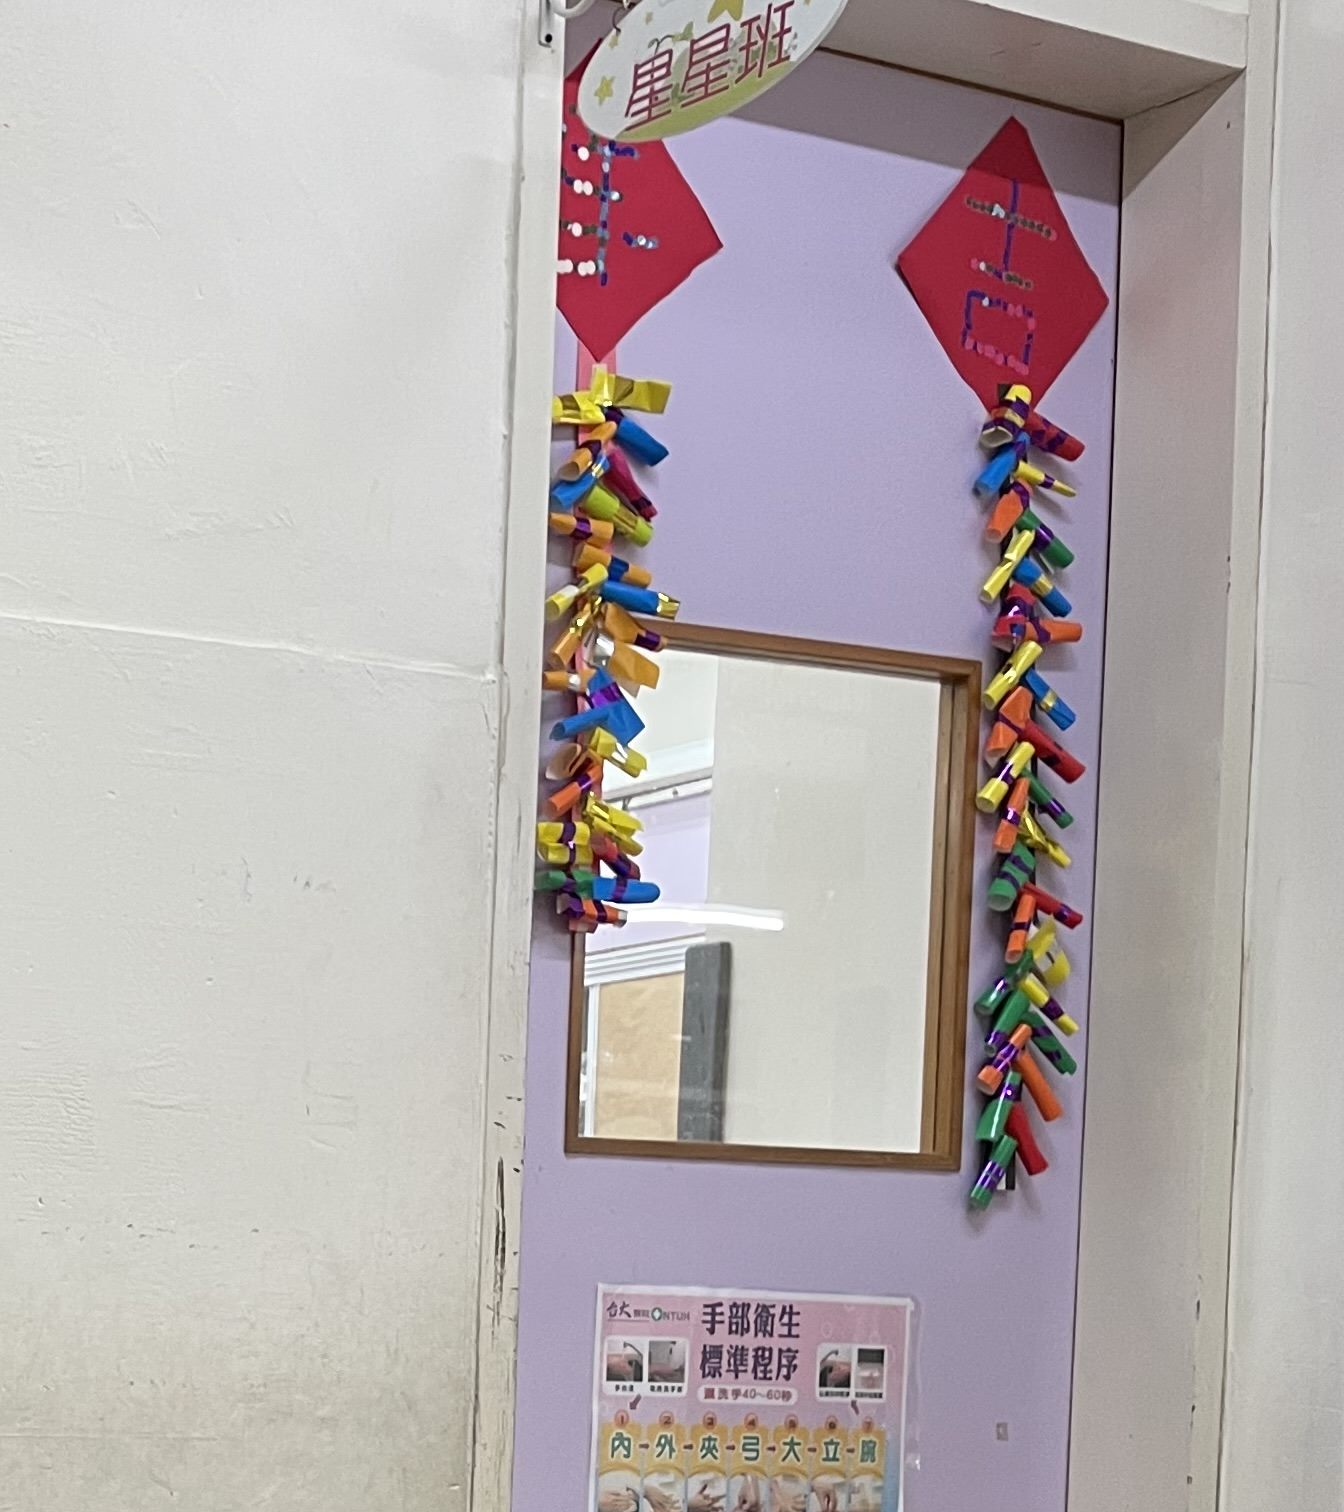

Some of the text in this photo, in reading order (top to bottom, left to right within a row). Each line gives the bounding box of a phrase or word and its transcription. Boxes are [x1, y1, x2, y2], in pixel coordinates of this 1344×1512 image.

[625, 0, 796, 132] 星星班
[701, 1301, 801, 1338] 手部衛生
[699, 1344, 800, 1382] 標準程序
